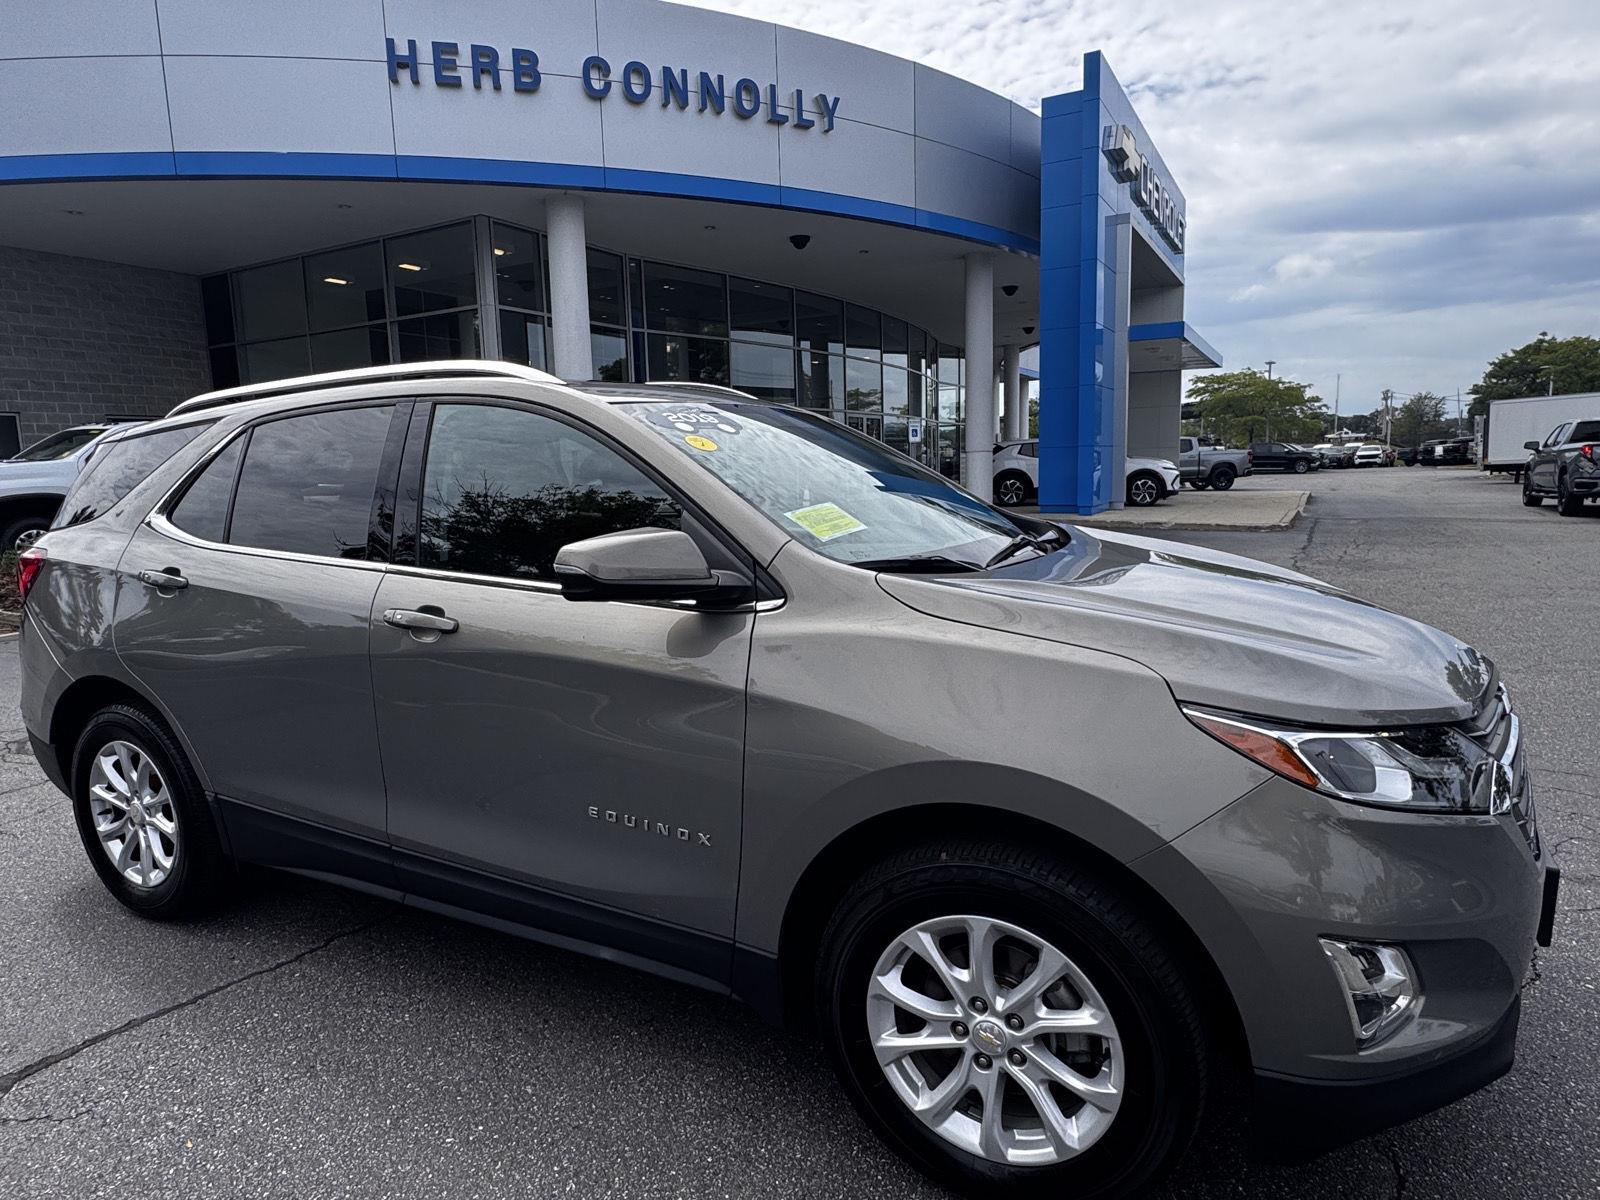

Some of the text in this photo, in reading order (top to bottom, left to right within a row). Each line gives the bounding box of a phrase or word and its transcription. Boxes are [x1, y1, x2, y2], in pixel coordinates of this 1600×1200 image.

[385, 37, 840, 133] HERB CONNOLLY
[1137, 152, 1186, 252] CHEVROLE
[587, 805, 712, 847] EQUINOX
